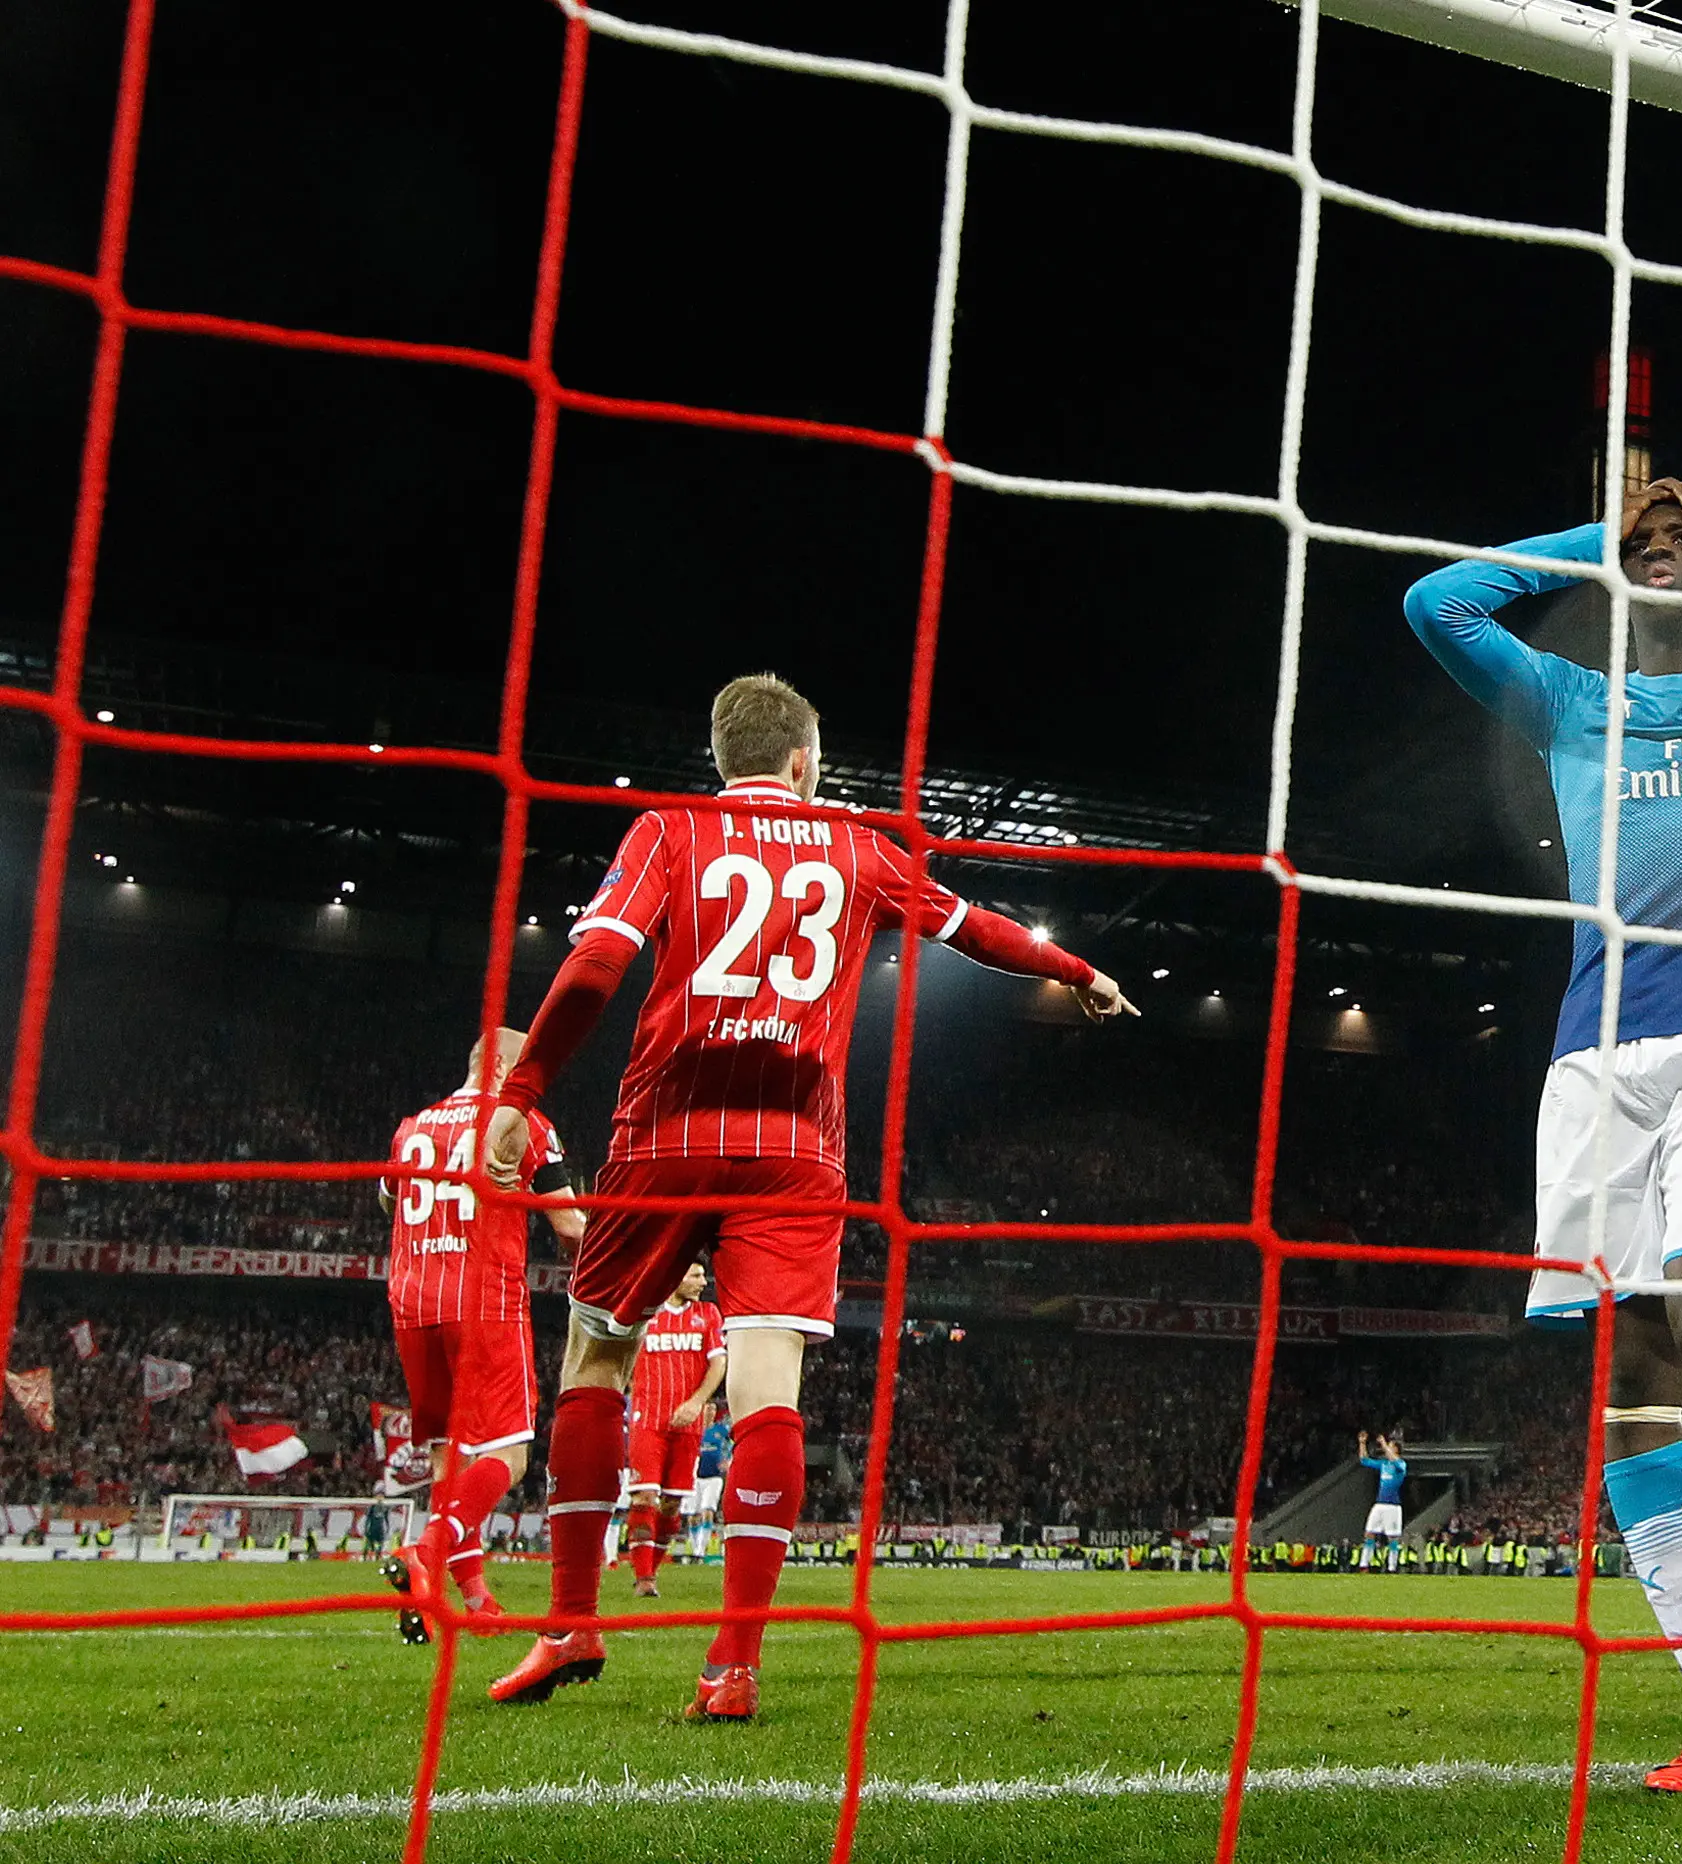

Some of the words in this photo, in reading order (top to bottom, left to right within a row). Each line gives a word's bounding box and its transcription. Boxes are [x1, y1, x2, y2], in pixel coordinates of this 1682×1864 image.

[725, 814, 744, 838] J.
[753, 816, 833, 847] HORN
[691, 853, 846, 1002] 23
[720, 1017, 748, 1041] FC
[751, 1015, 798, 1046] KÖLN
[401, 1127, 476, 1226] 34
[645, 1333, 703, 1353] REWE
